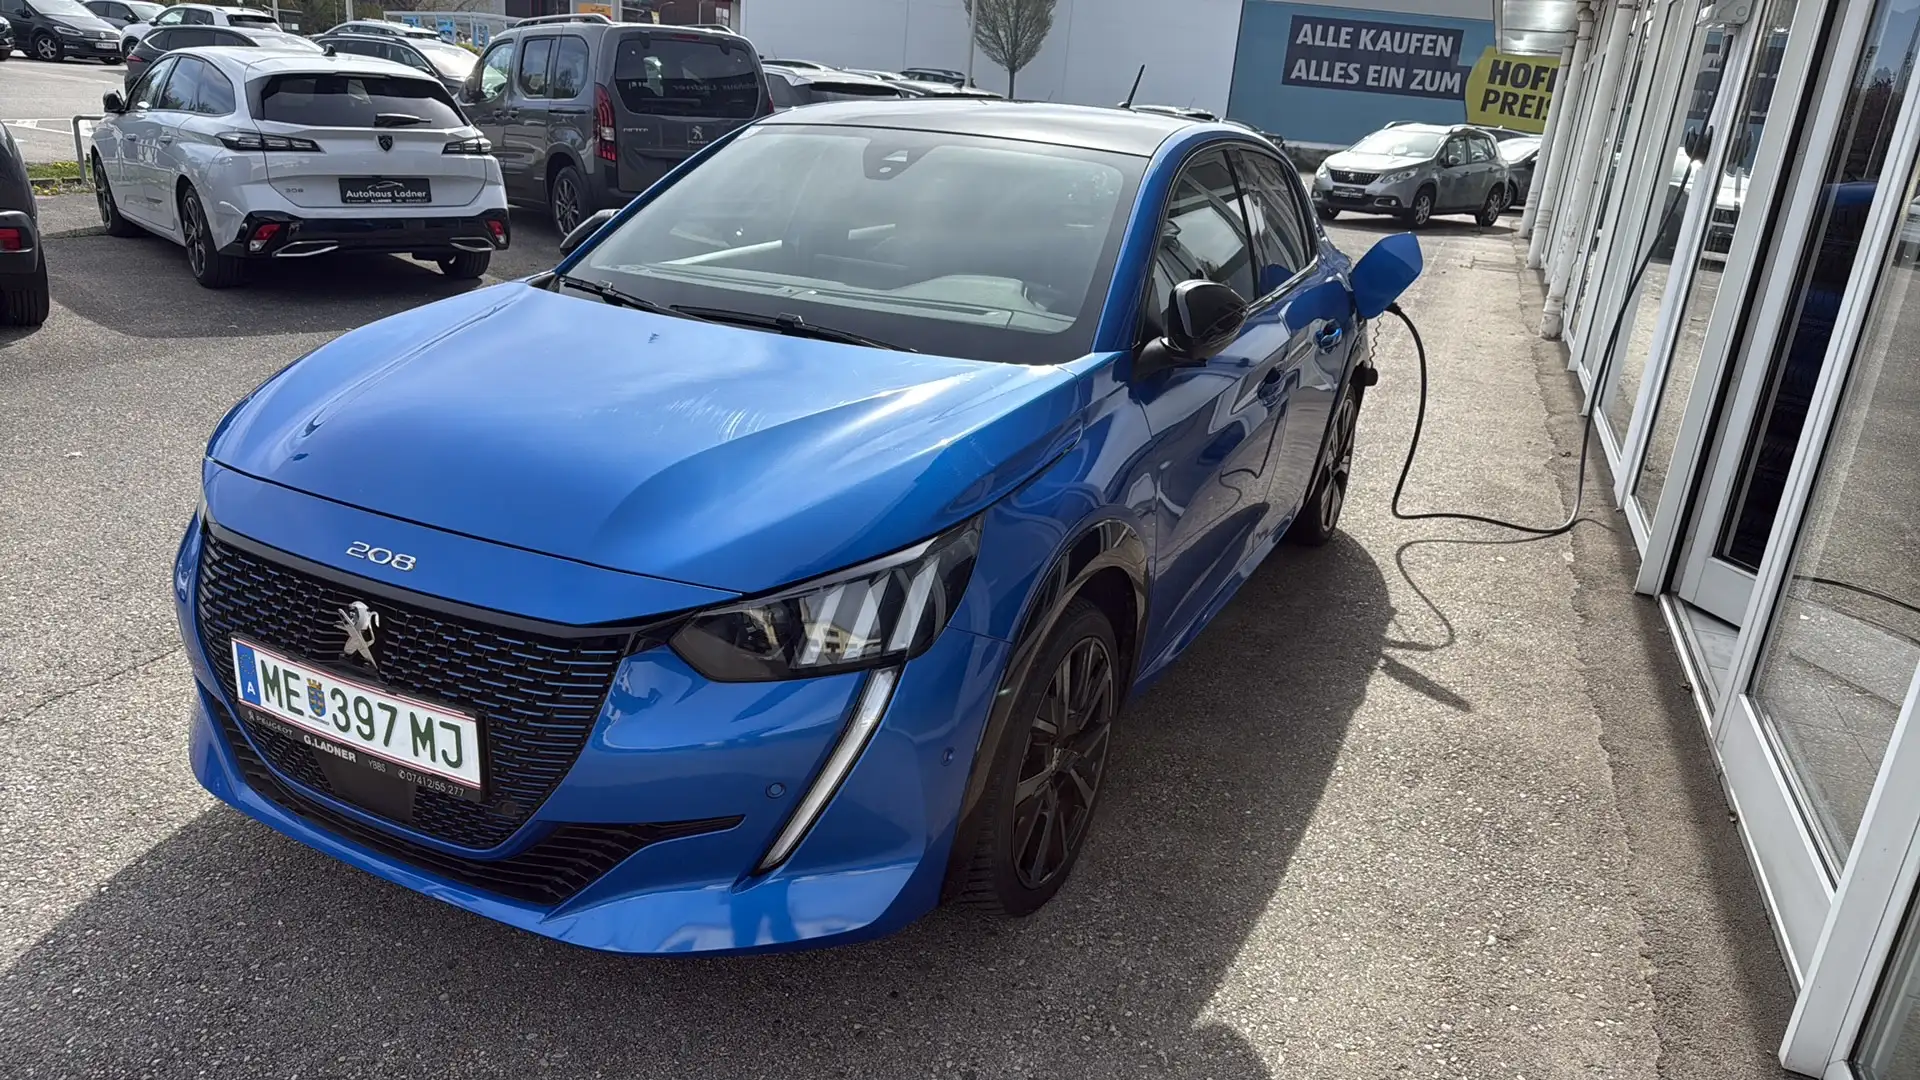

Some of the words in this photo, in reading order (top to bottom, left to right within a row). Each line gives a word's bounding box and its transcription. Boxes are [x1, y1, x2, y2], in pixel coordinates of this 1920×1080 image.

[1296, 23, 1353, 49] ALLE
[1357, 28, 1454, 58] KAUFEN
[1290, 58, 1361, 85] ALLES
[1365, 65, 1404, 89] EIN
[1409, 68, 1462, 95] ZUM
[346, 190, 392, 198] Autohaus
[394, 189, 427, 198] Ladner
[345, 541, 417, 571] 208
[246, 681, 256, 695] A
[260, 659, 304, 717] ME
[330, 687, 398, 748] 397
[409, 711, 462, 768] MJ
[256, 715, 293, 736] PEUGEOT
[303, 734, 357, 763] G.LADNER
